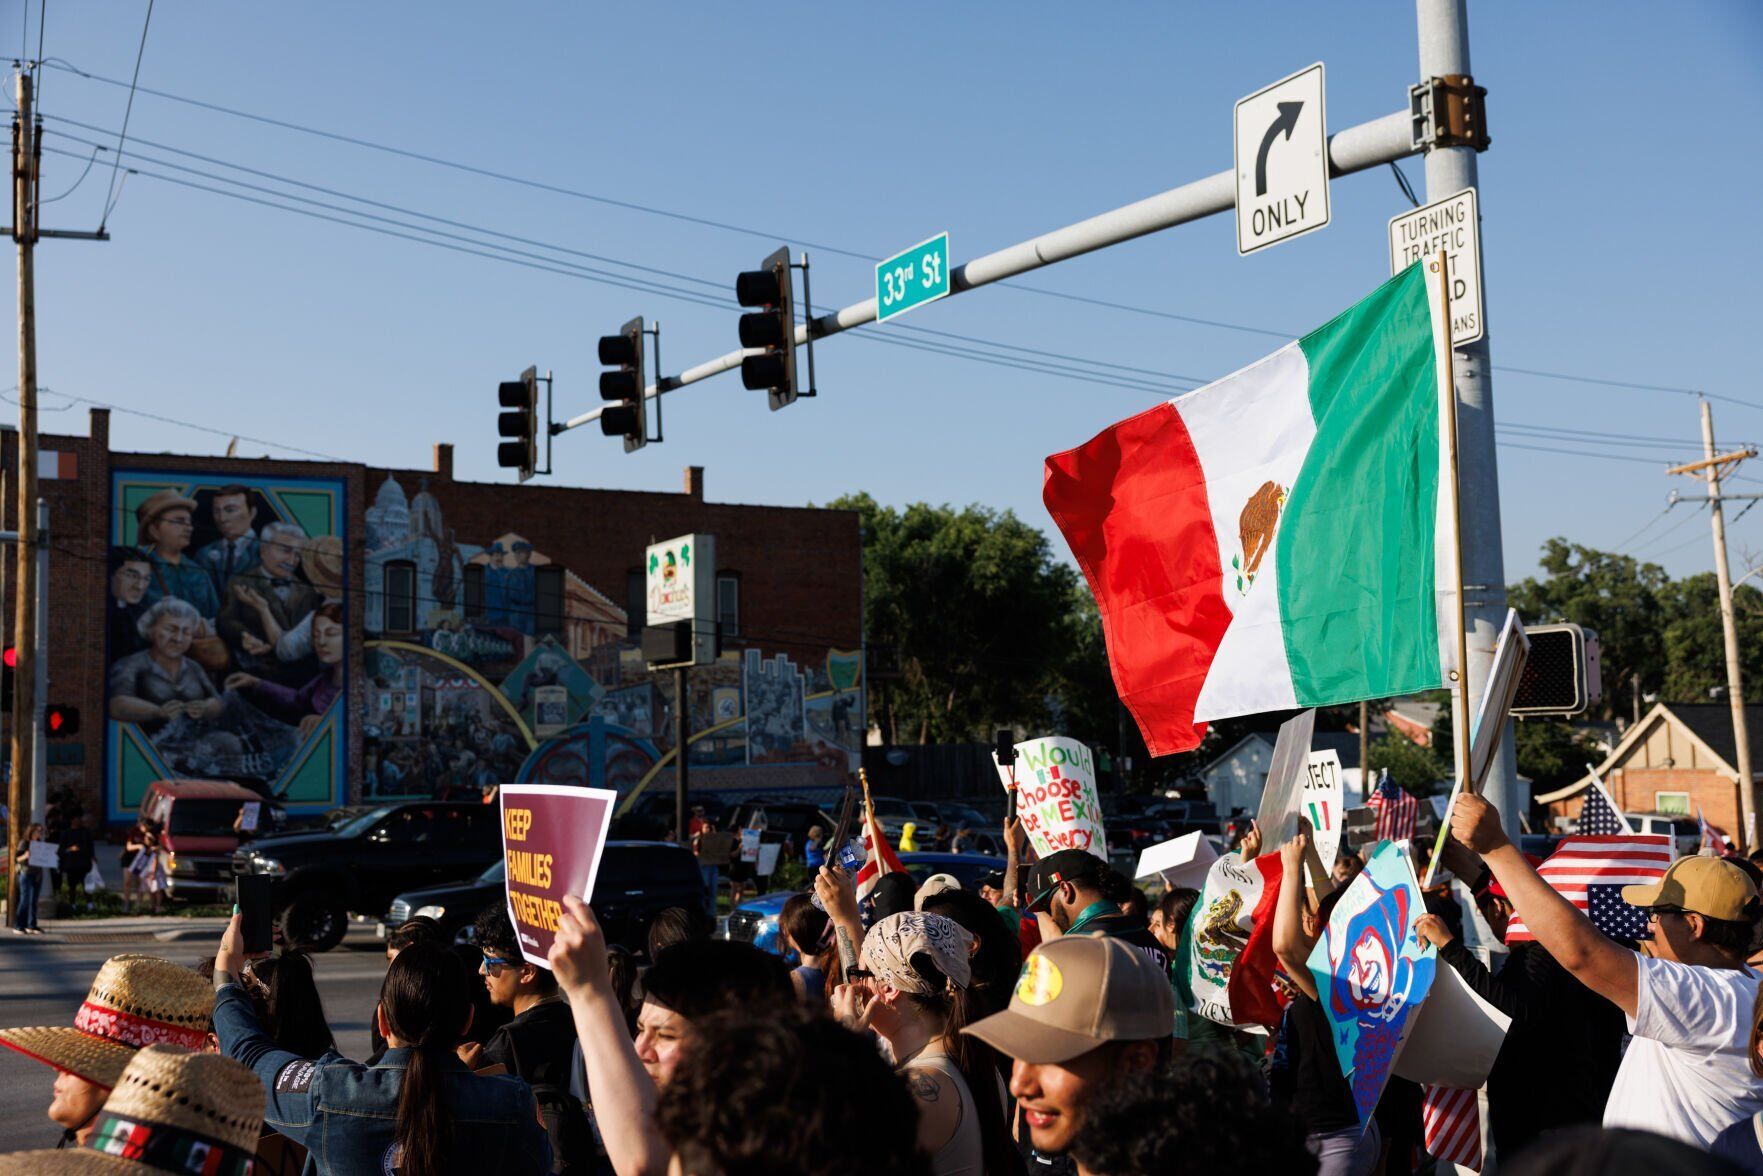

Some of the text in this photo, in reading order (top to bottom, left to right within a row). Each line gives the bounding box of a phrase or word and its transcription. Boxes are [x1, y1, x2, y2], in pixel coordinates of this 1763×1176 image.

[1252, 190, 1309, 236] ONLY
[1400, 201, 1465, 243] TURNING
[1403, 228, 1465, 267] TRAFFIC
[883, 251, 941, 306] 33rd St
[504, 808, 532, 841] KEEP
[1021, 814, 1041, 832] be
[1043, 829, 1092, 851] Every
[507, 849, 553, 889] FAMILIES
